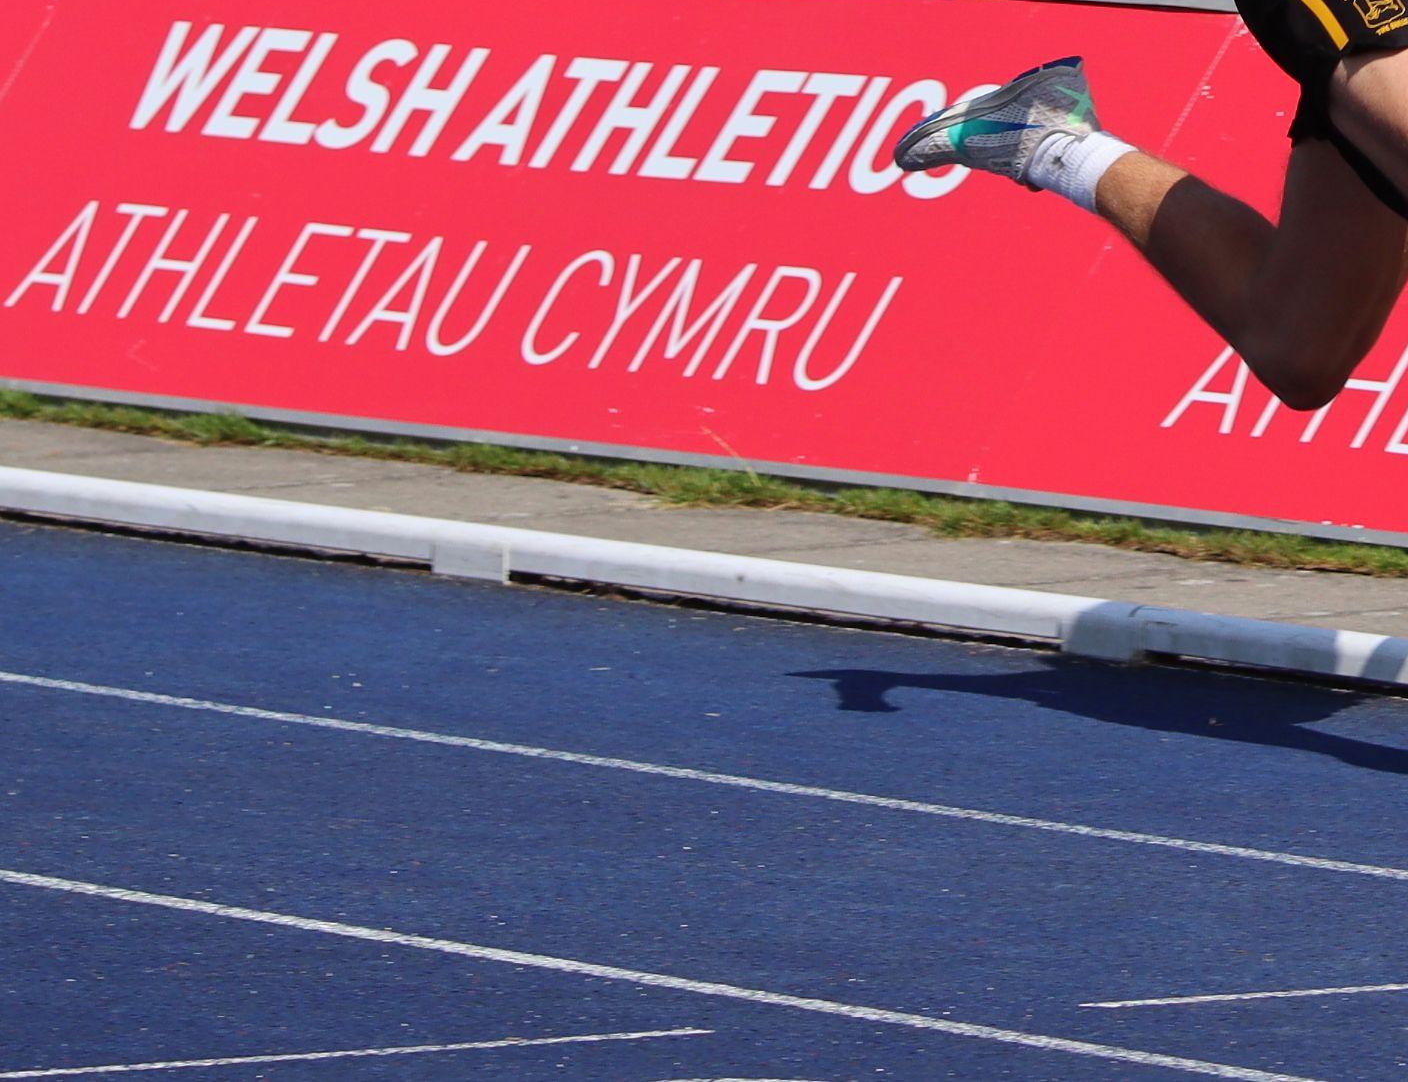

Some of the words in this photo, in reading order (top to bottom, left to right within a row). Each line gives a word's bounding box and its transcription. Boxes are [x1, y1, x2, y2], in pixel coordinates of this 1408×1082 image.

[130, 21, 490, 157] WELSH
[5, 200, 531, 356] ATHLETAU
[521, 250, 903, 391] CYMRU
